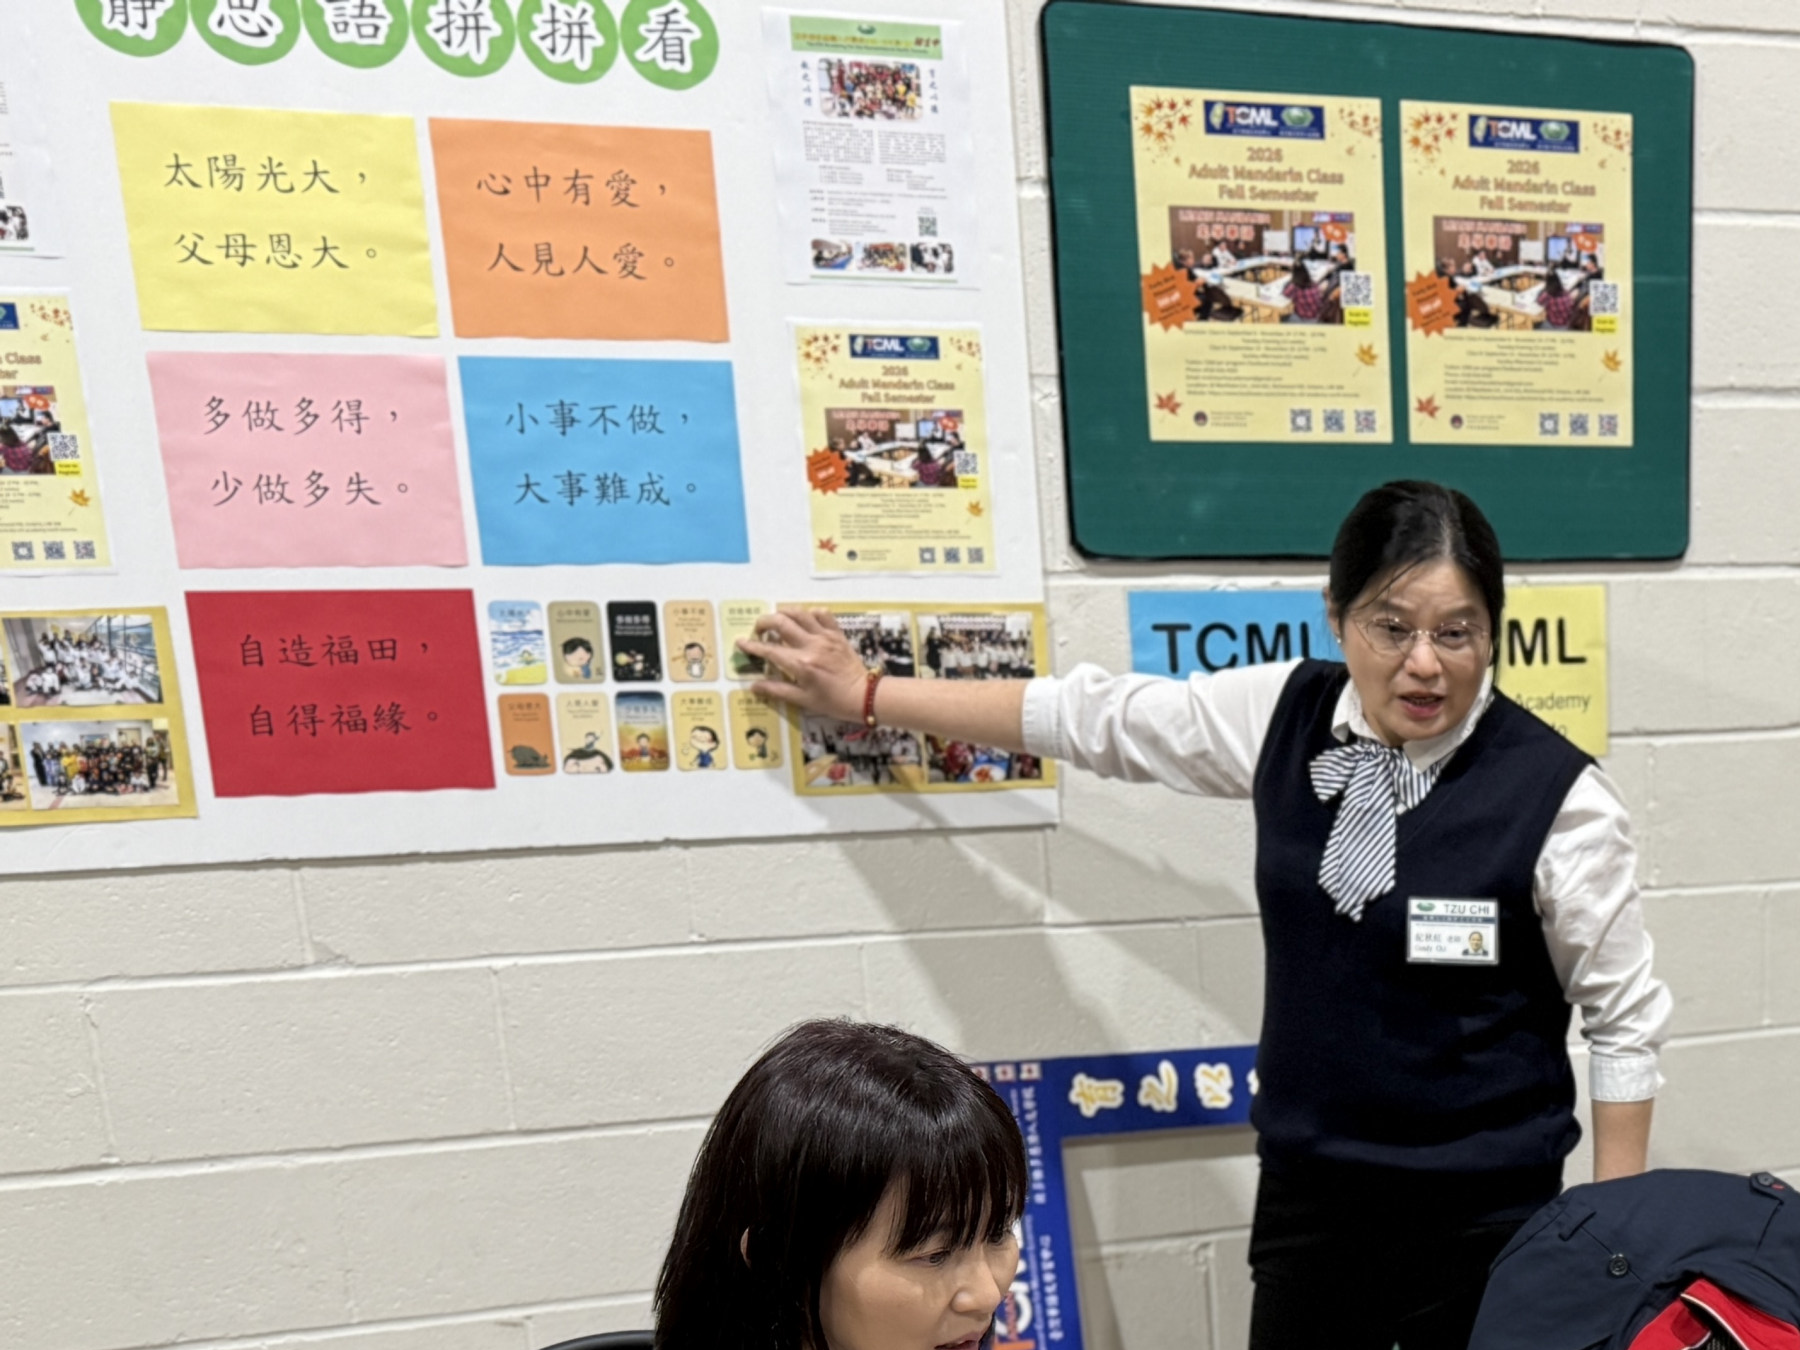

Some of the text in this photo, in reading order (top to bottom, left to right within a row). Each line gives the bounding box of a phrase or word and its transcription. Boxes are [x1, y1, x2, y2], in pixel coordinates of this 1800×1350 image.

[1226, 106, 1278, 127] TCML
[1488, 120, 1536, 141] TCML
[163, 153, 369, 194] 太陽光大，
[476, 166, 669, 208] 心中有愛，
[1188, 163, 1344, 185] Adult Mandarin Class
[1452, 174, 1596, 197] Adult Mandarin Class
[1218, 184, 1318, 203] Fall Semester
[1479, 194, 1571, 214] Fall Semester
[173, 232, 377, 271] 父母恩大。
[486, 242, 677, 280] 人見人愛。
[865, 338, 904, 352] TCML
[203, 395, 400, 437] 多做多得，
[505, 400, 690, 438] 小事不做，
[210, 470, 410, 508] 少做多失。
[514, 472, 698, 508] 大事難成。
[239, 634, 431, 668] 自造福田，
[1507, 617, 1588, 666] ML
[249, 702, 438, 739] 自得福緣。
[1515, 694, 1590, 714] Academy
[1443, 903, 1490, 915] TZU CHI
[1069, 1060, 1260, 1118] 育之以
